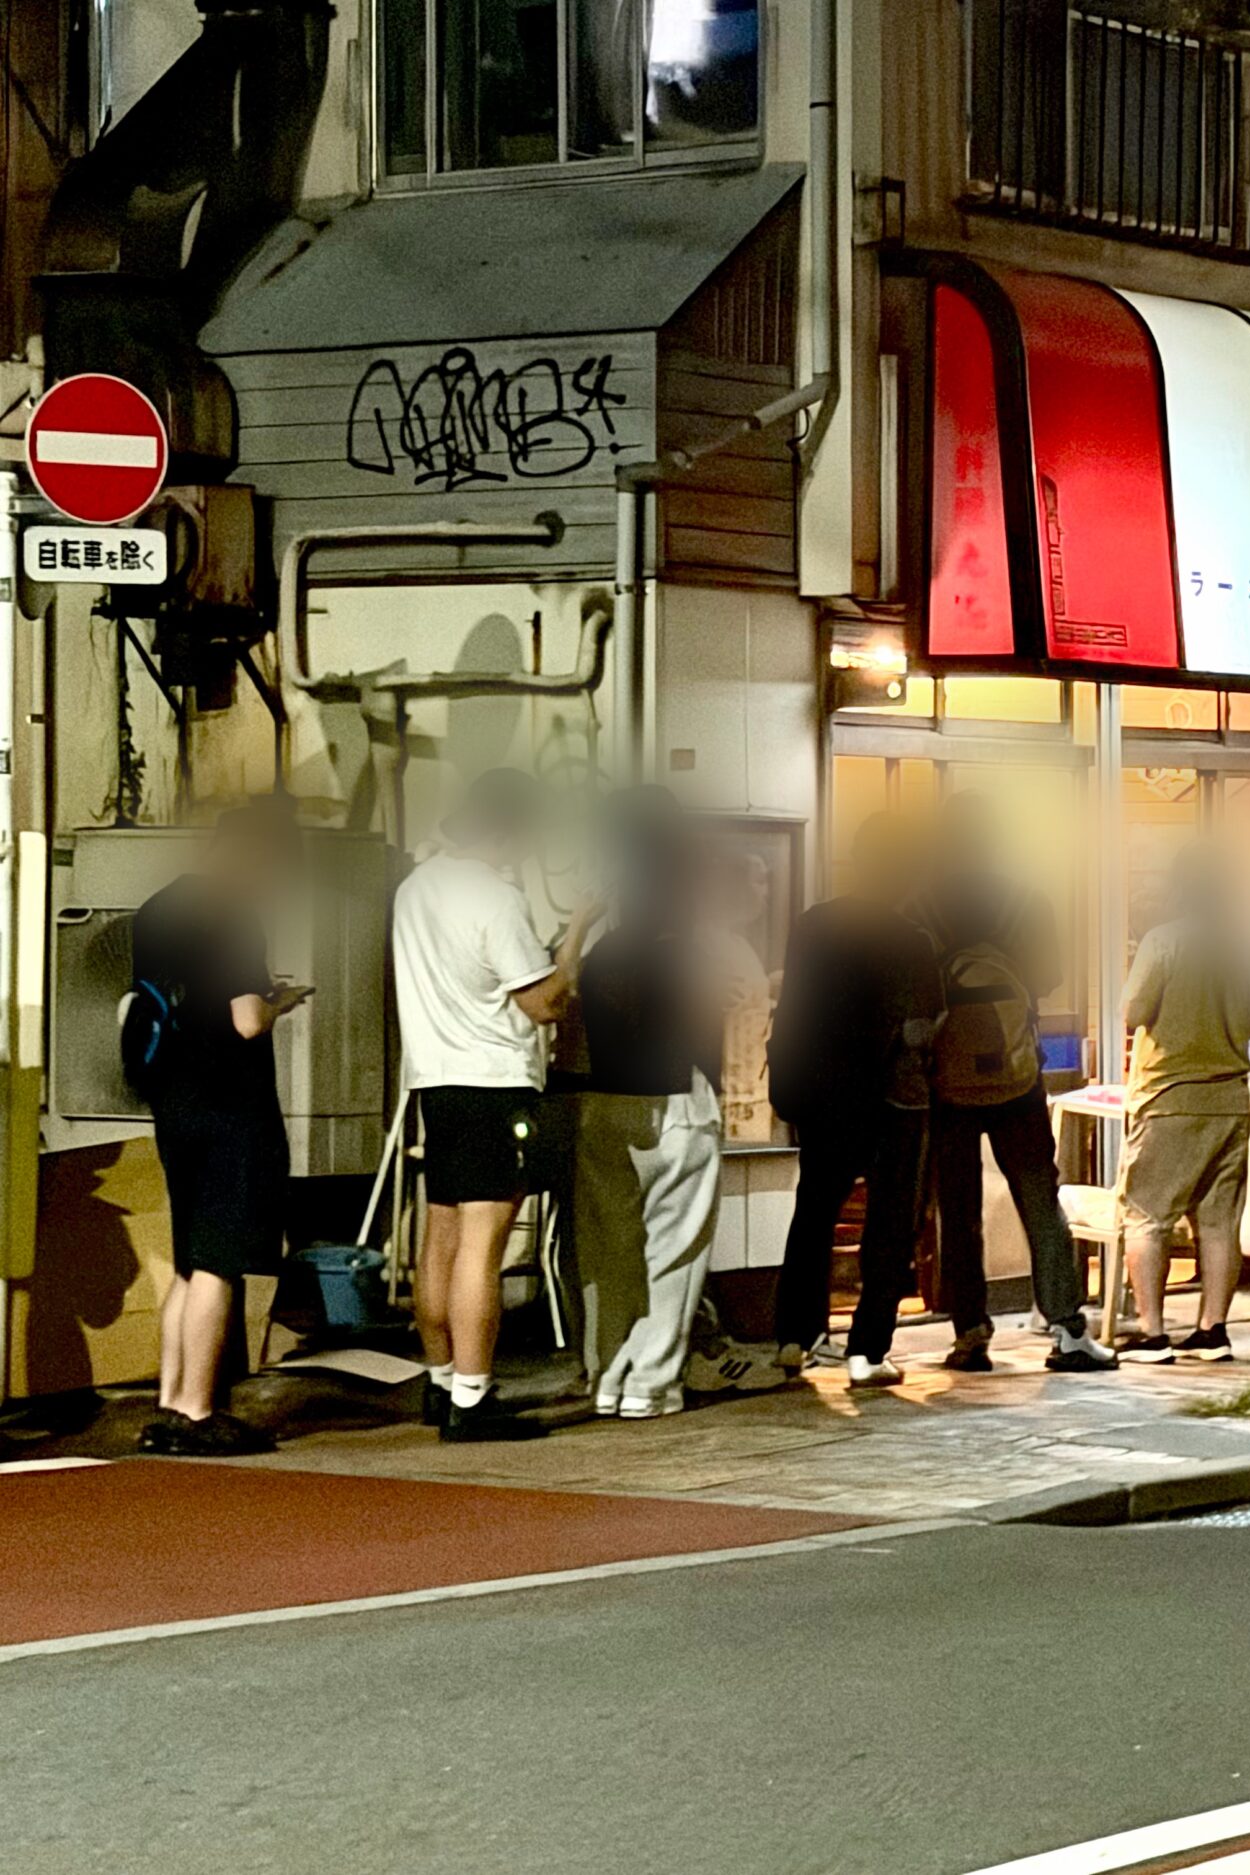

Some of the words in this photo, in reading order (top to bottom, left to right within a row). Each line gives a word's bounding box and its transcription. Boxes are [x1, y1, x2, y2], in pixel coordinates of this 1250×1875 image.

[38, 539, 155, 571] 自転車を除く
